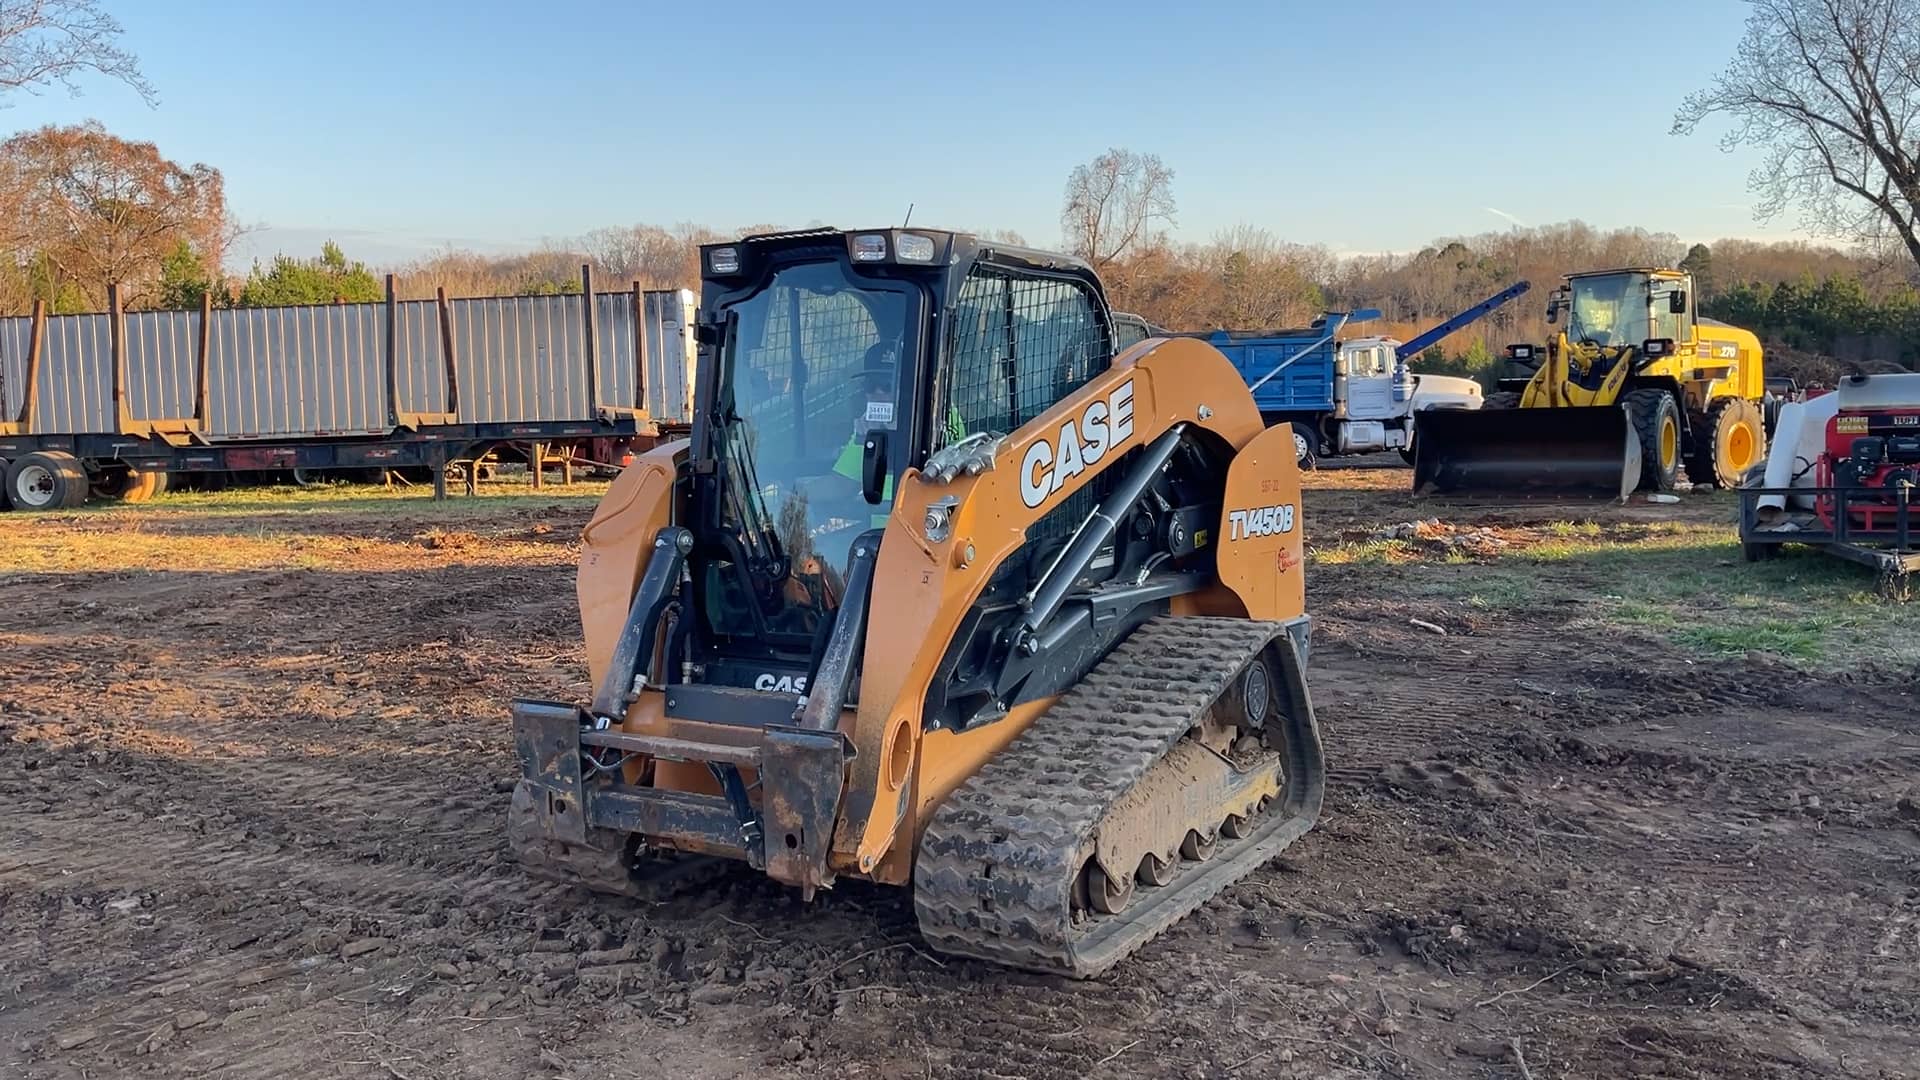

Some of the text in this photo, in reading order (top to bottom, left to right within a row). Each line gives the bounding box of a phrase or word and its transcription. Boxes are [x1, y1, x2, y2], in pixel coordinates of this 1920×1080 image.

[1719, 345, 1737, 359] 270
[1020, 378, 1134, 508] CASE
[1229, 503, 1294, 541] TV450B
[754, 673, 807, 694] CAS
